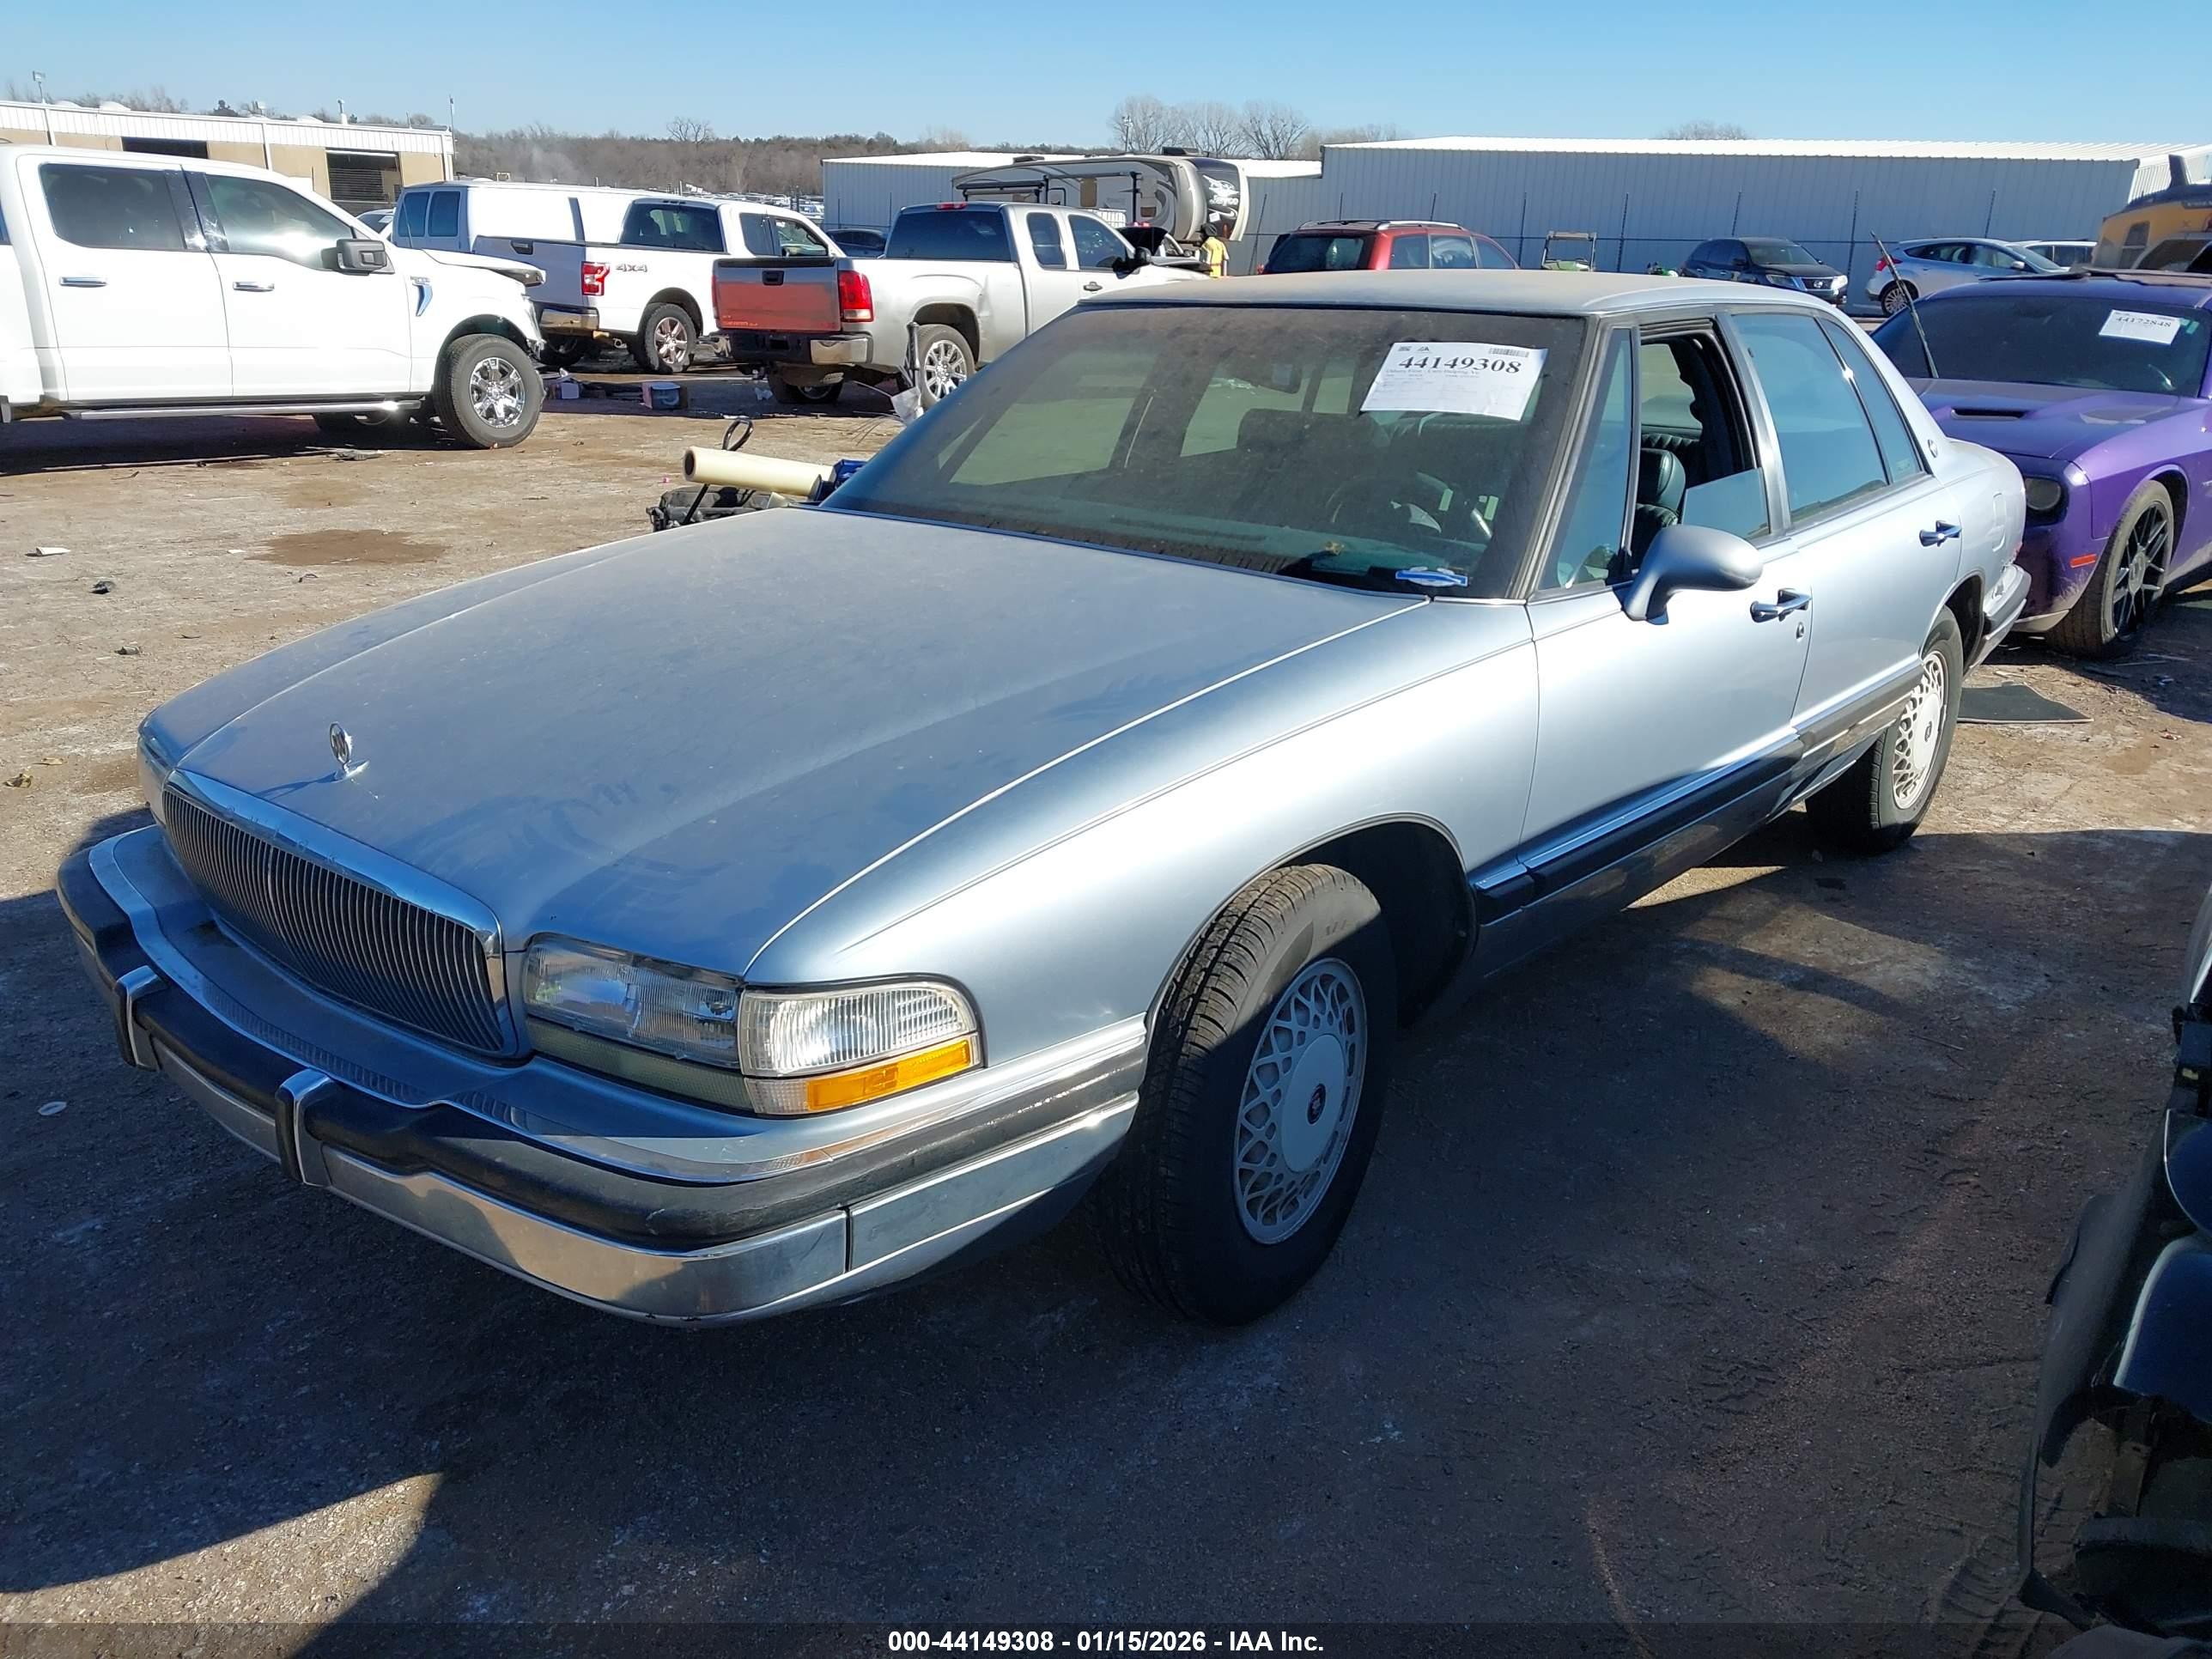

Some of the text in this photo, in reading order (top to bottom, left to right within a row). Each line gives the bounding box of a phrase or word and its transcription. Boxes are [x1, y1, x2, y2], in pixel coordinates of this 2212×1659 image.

[1208, 194, 1239, 207] Jayco
[2115, 316, 2172, 328] 44172848
[1398, 356, 1522, 374] 44149308
